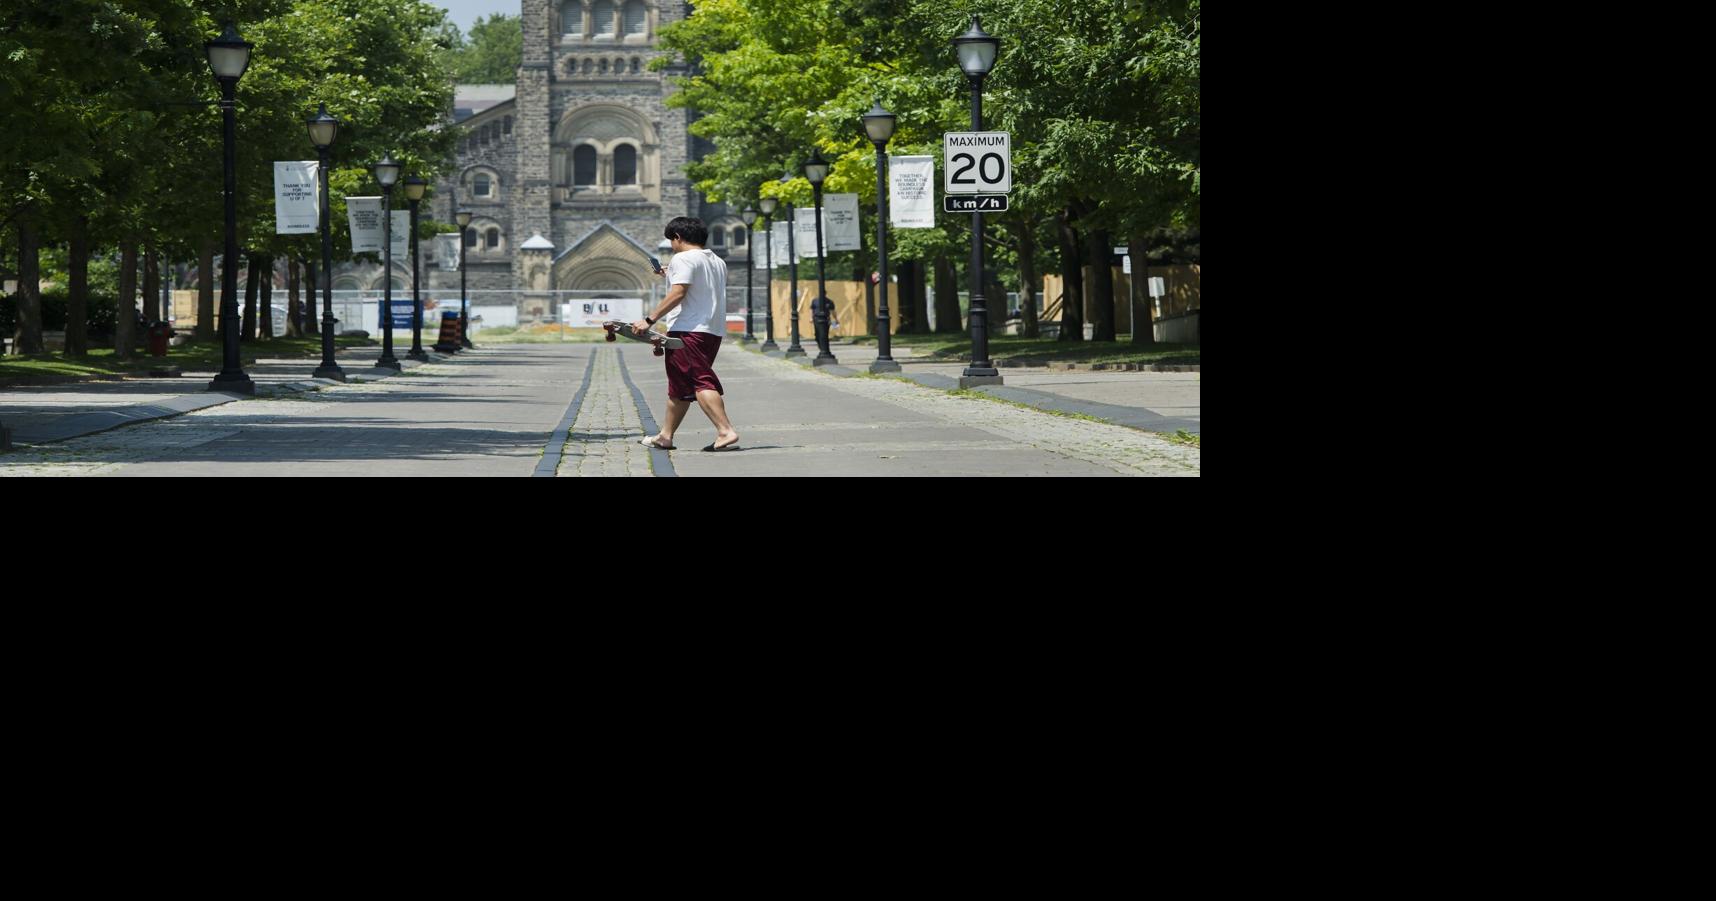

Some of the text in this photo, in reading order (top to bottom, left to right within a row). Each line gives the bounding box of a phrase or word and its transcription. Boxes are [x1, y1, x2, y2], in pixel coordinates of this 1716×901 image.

[949, 136, 1005, 147] MAXIMUM
[950, 152, 1005, 185] 20
[952, 198, 1000, 209] km/h
